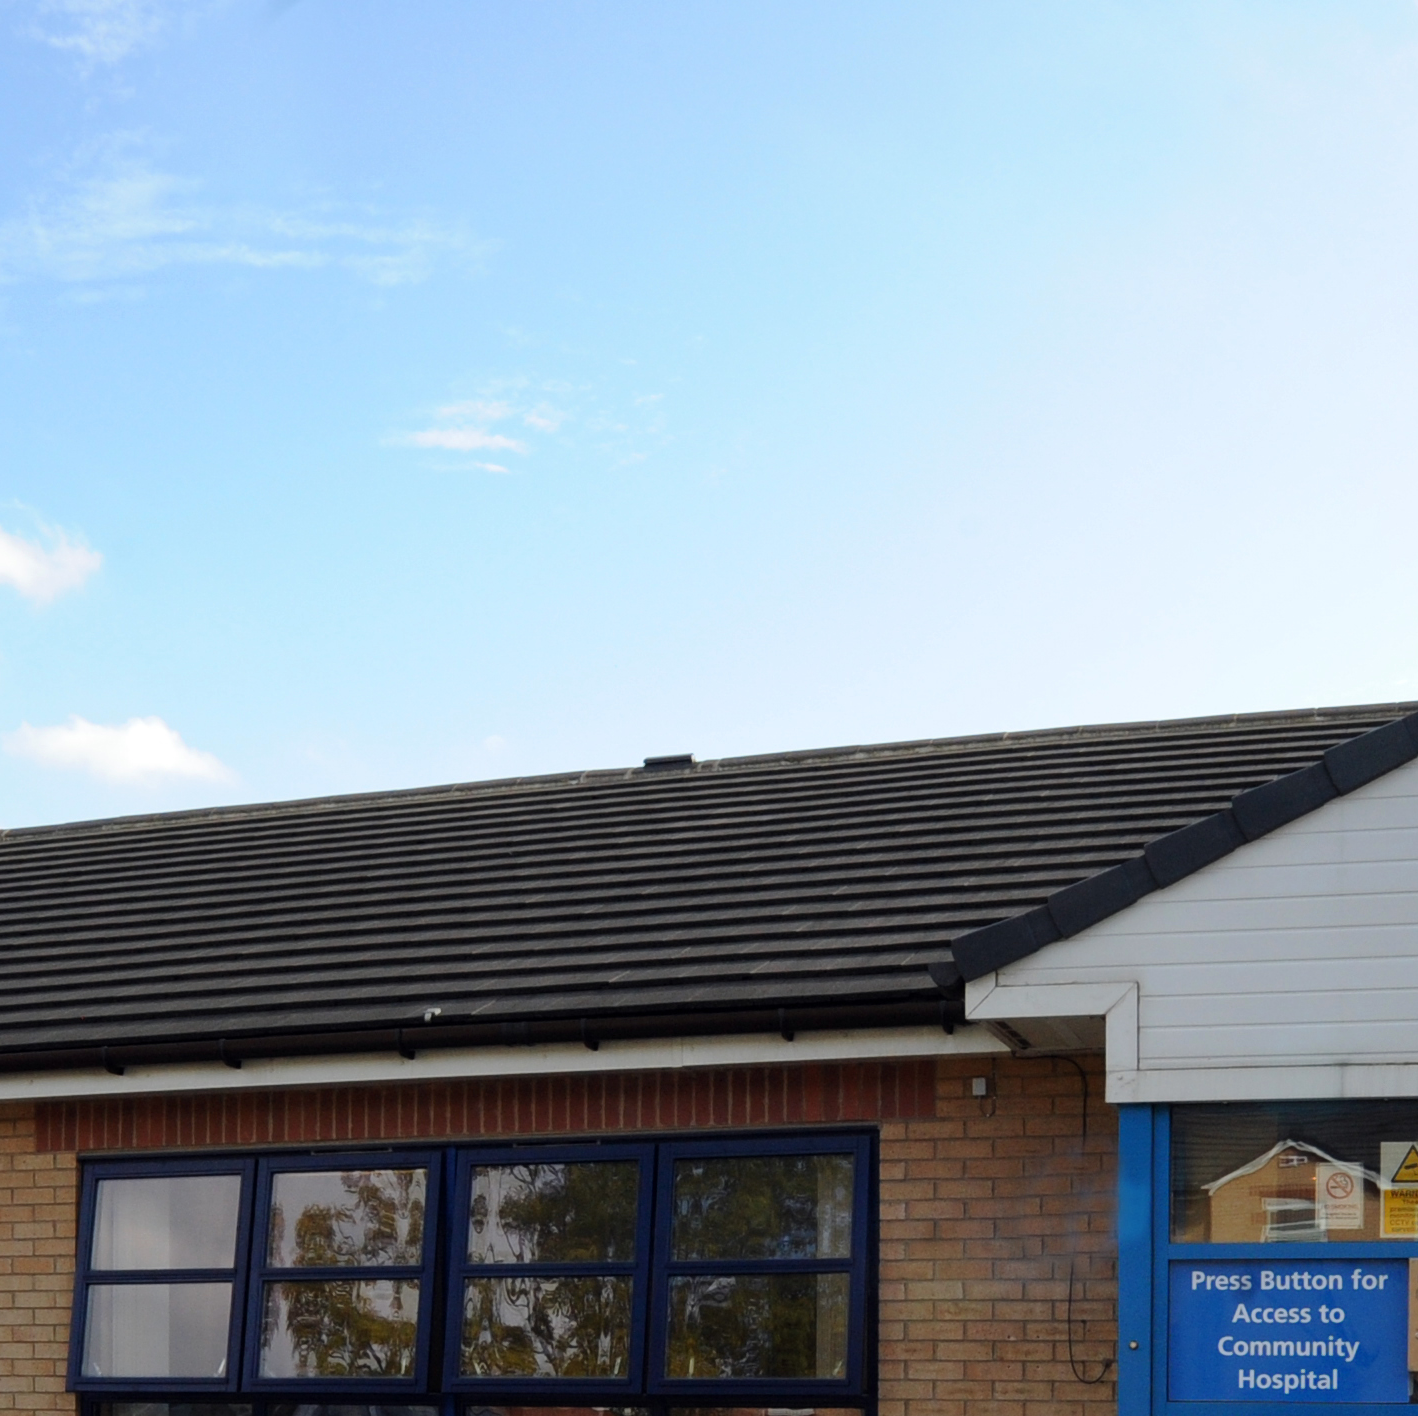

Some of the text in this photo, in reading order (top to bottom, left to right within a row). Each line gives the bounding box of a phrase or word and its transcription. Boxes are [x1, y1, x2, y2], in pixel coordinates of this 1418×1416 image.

[1191, 1268, 1389, 1291] Press Button for
[1231, 1303, 1346, 1324] Access to
[1217, 1336, 1360, 1362] Community
[1238, 1368, 1338, 1395] Hospital
